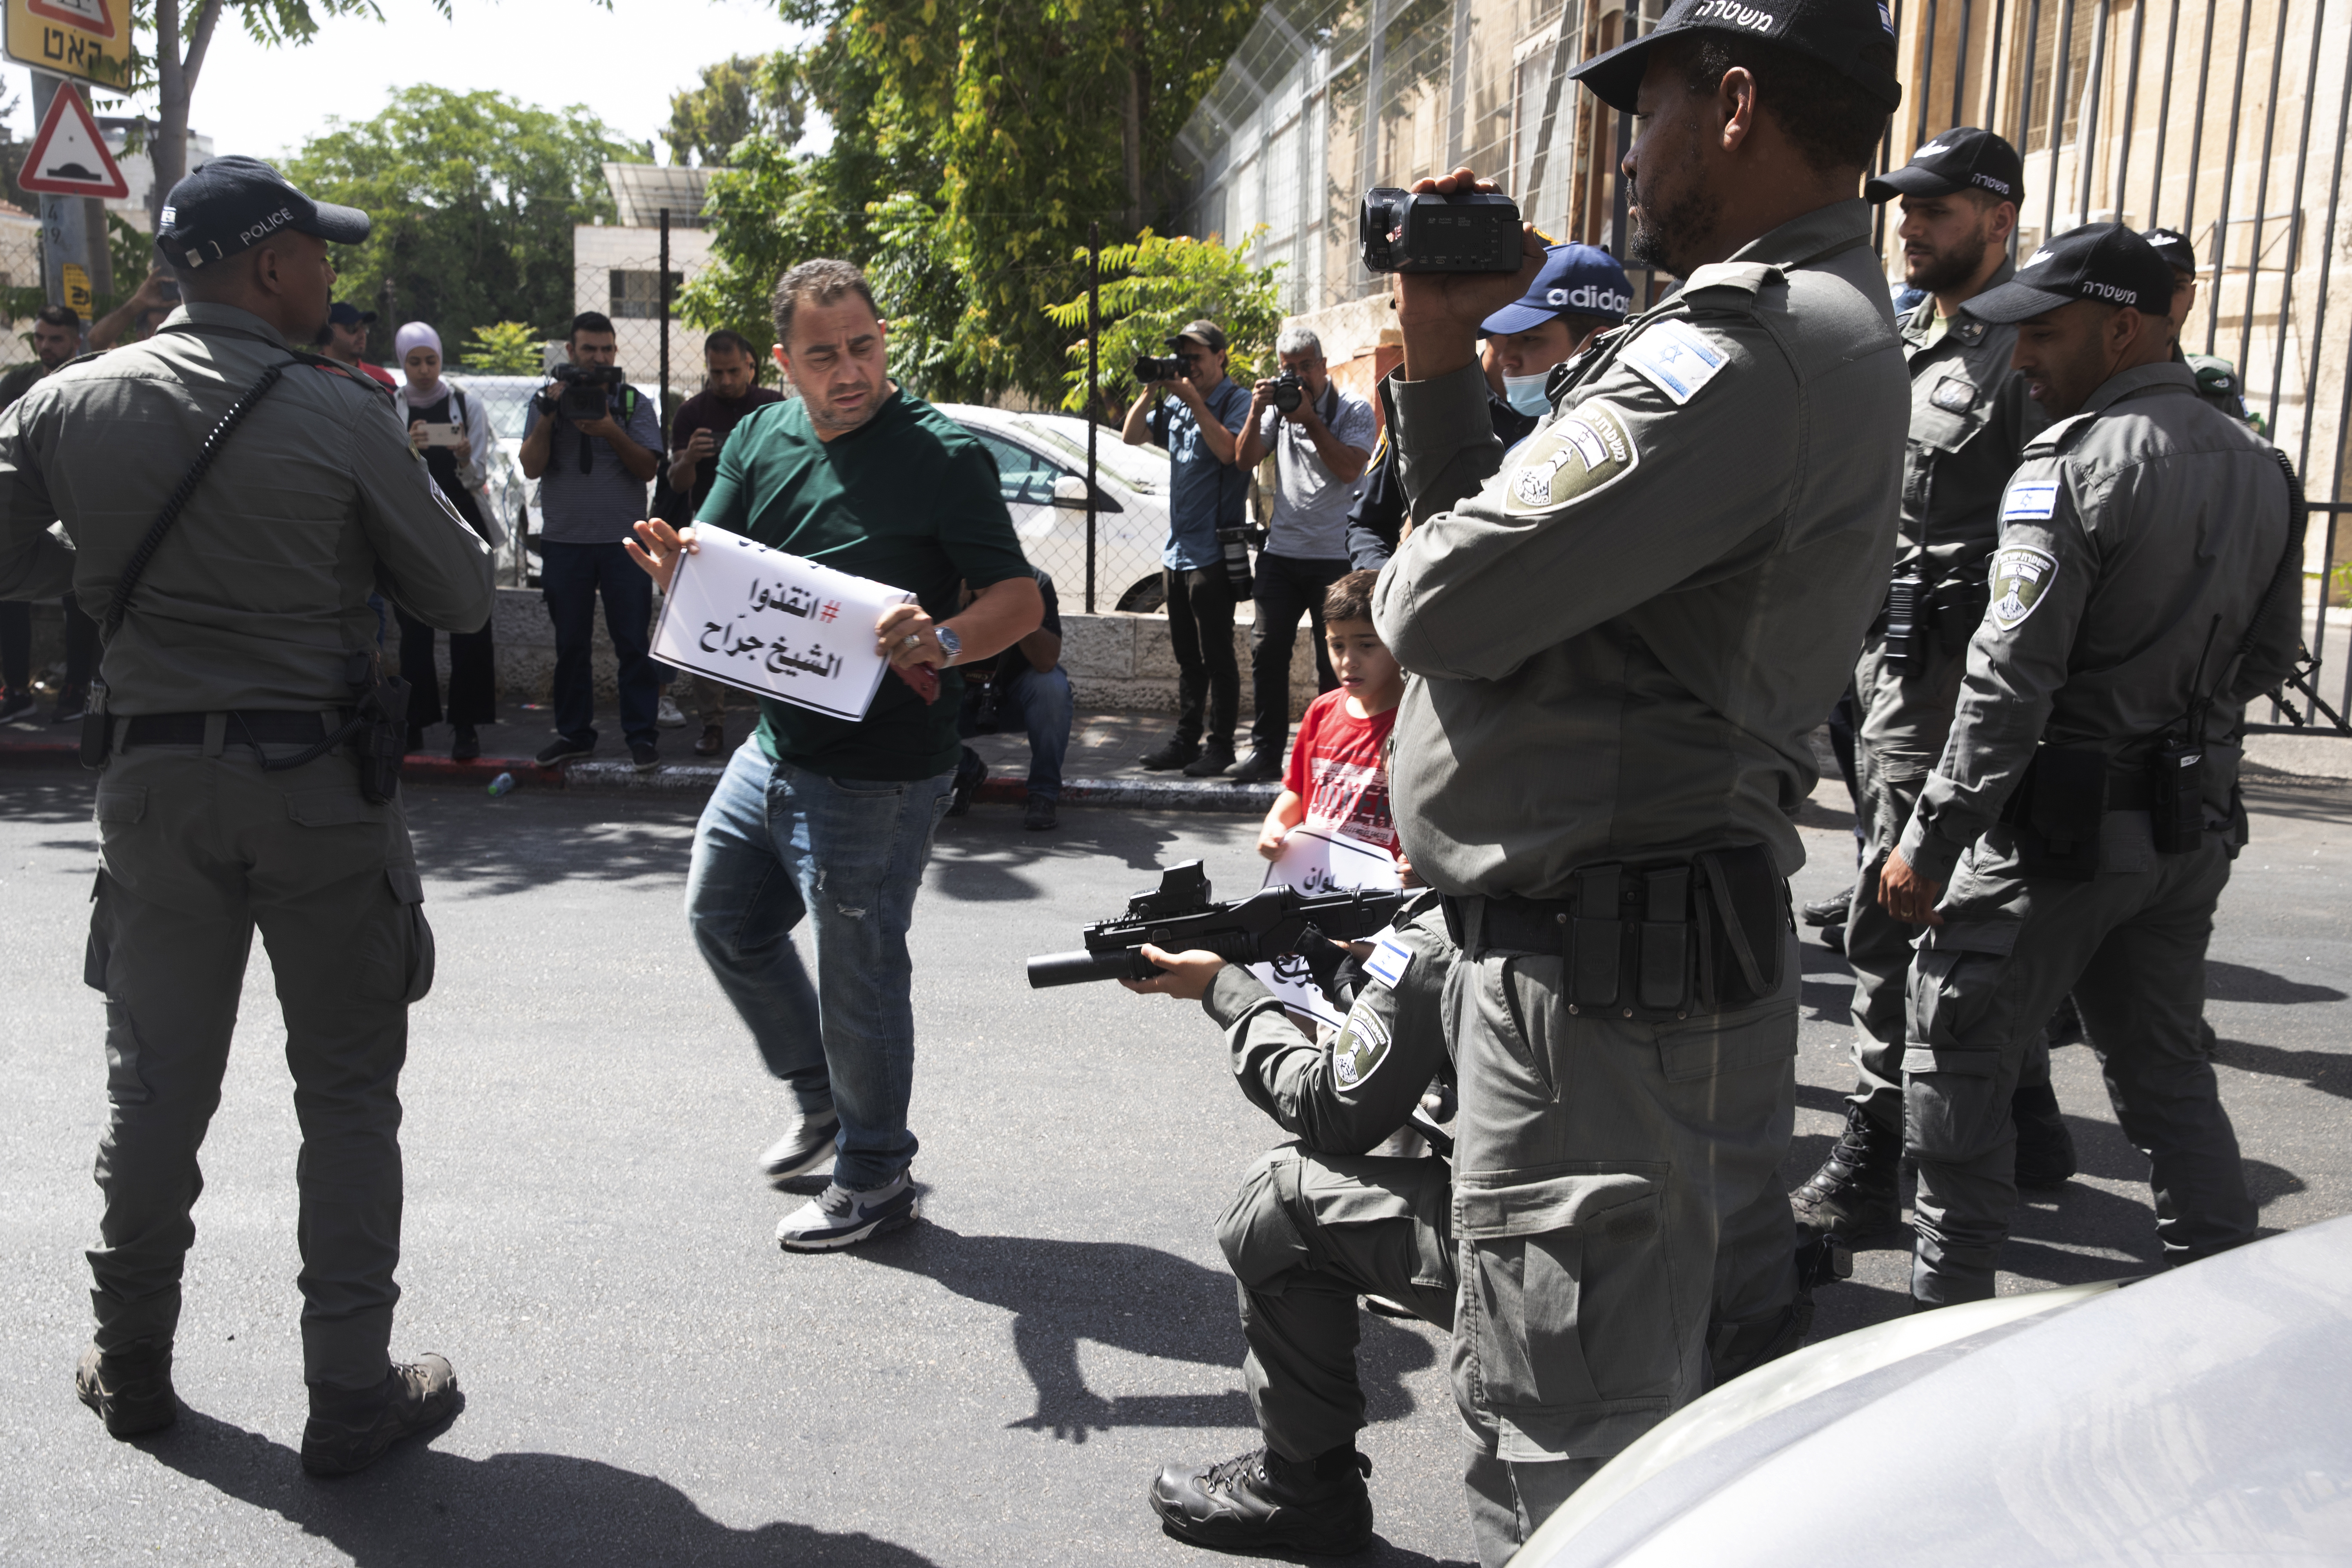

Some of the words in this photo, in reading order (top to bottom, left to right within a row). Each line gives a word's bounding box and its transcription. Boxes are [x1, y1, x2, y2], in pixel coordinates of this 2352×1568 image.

[1695, 0, 1773, 32] משטרה
[44, 27, 102, 70] האט
[1971, 173, 2009, 195] משטרה
[240, 207, 294, 246] POLICE
[1546, 285, 1630, 314] adidas
[2082, 281, 2137, 304] משטרה
[1595, 416, 1627, 462] משטרת
[766, 636, 844, 680] الشيخ
[1367, 1016, 1387, 1045] משטרת
